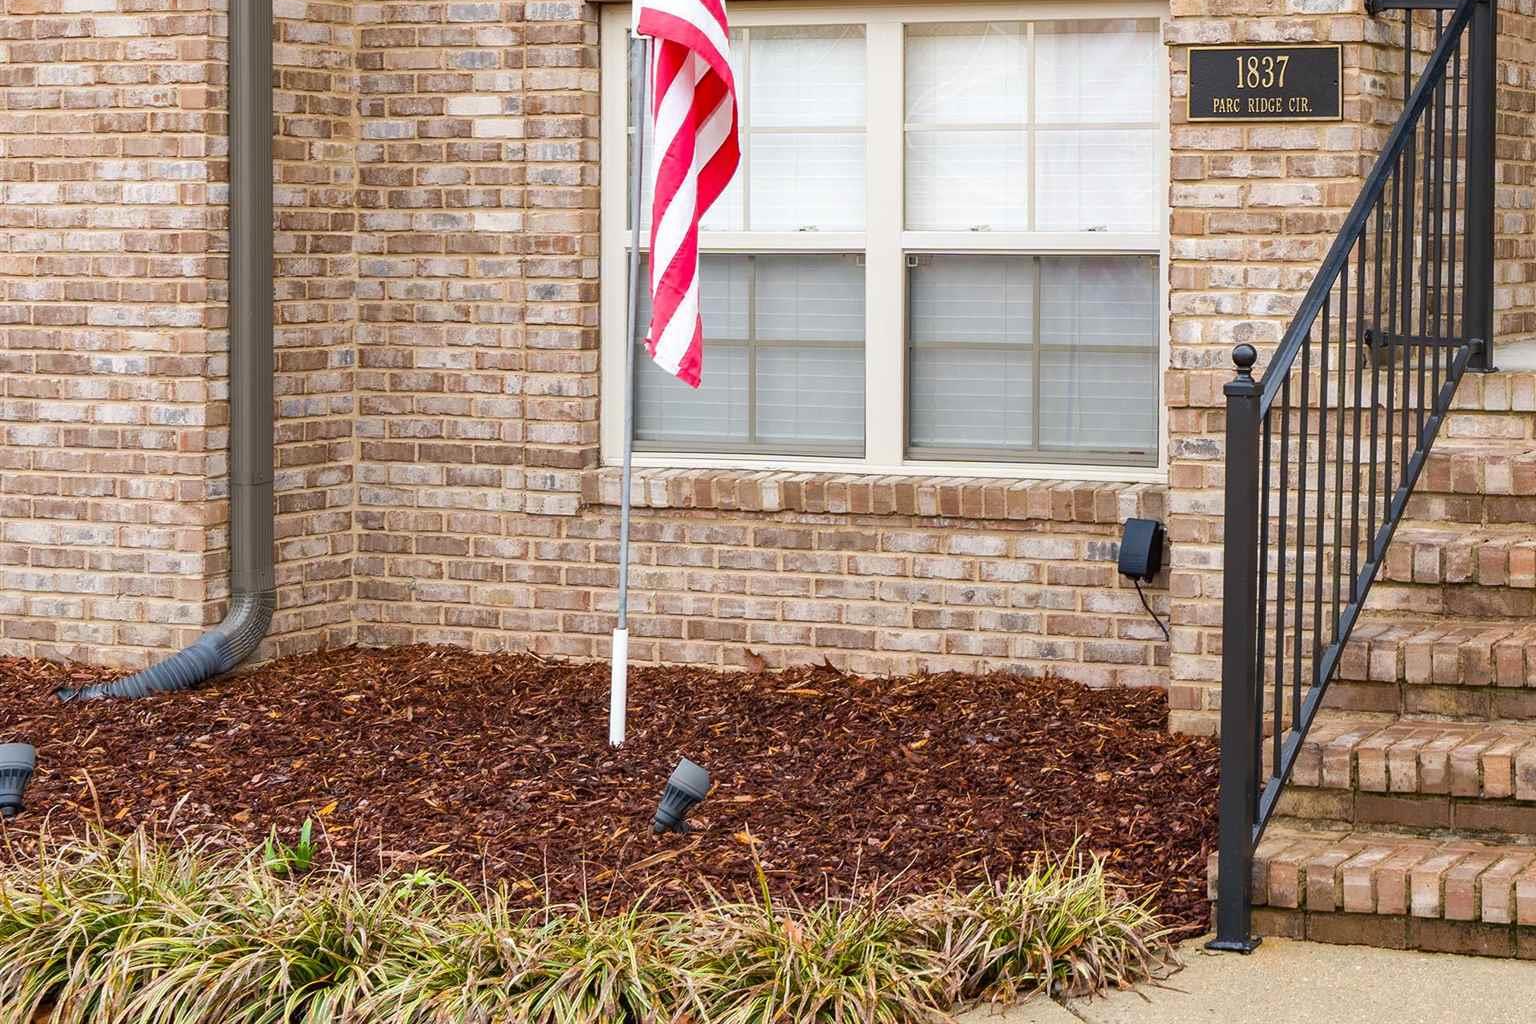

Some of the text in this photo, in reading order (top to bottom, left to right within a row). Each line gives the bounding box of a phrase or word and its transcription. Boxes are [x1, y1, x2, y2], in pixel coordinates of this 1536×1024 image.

[1236, 55, 1289, 88] 1837
[1213, 96, 1313, 113] PARC RIDGE CIR.
